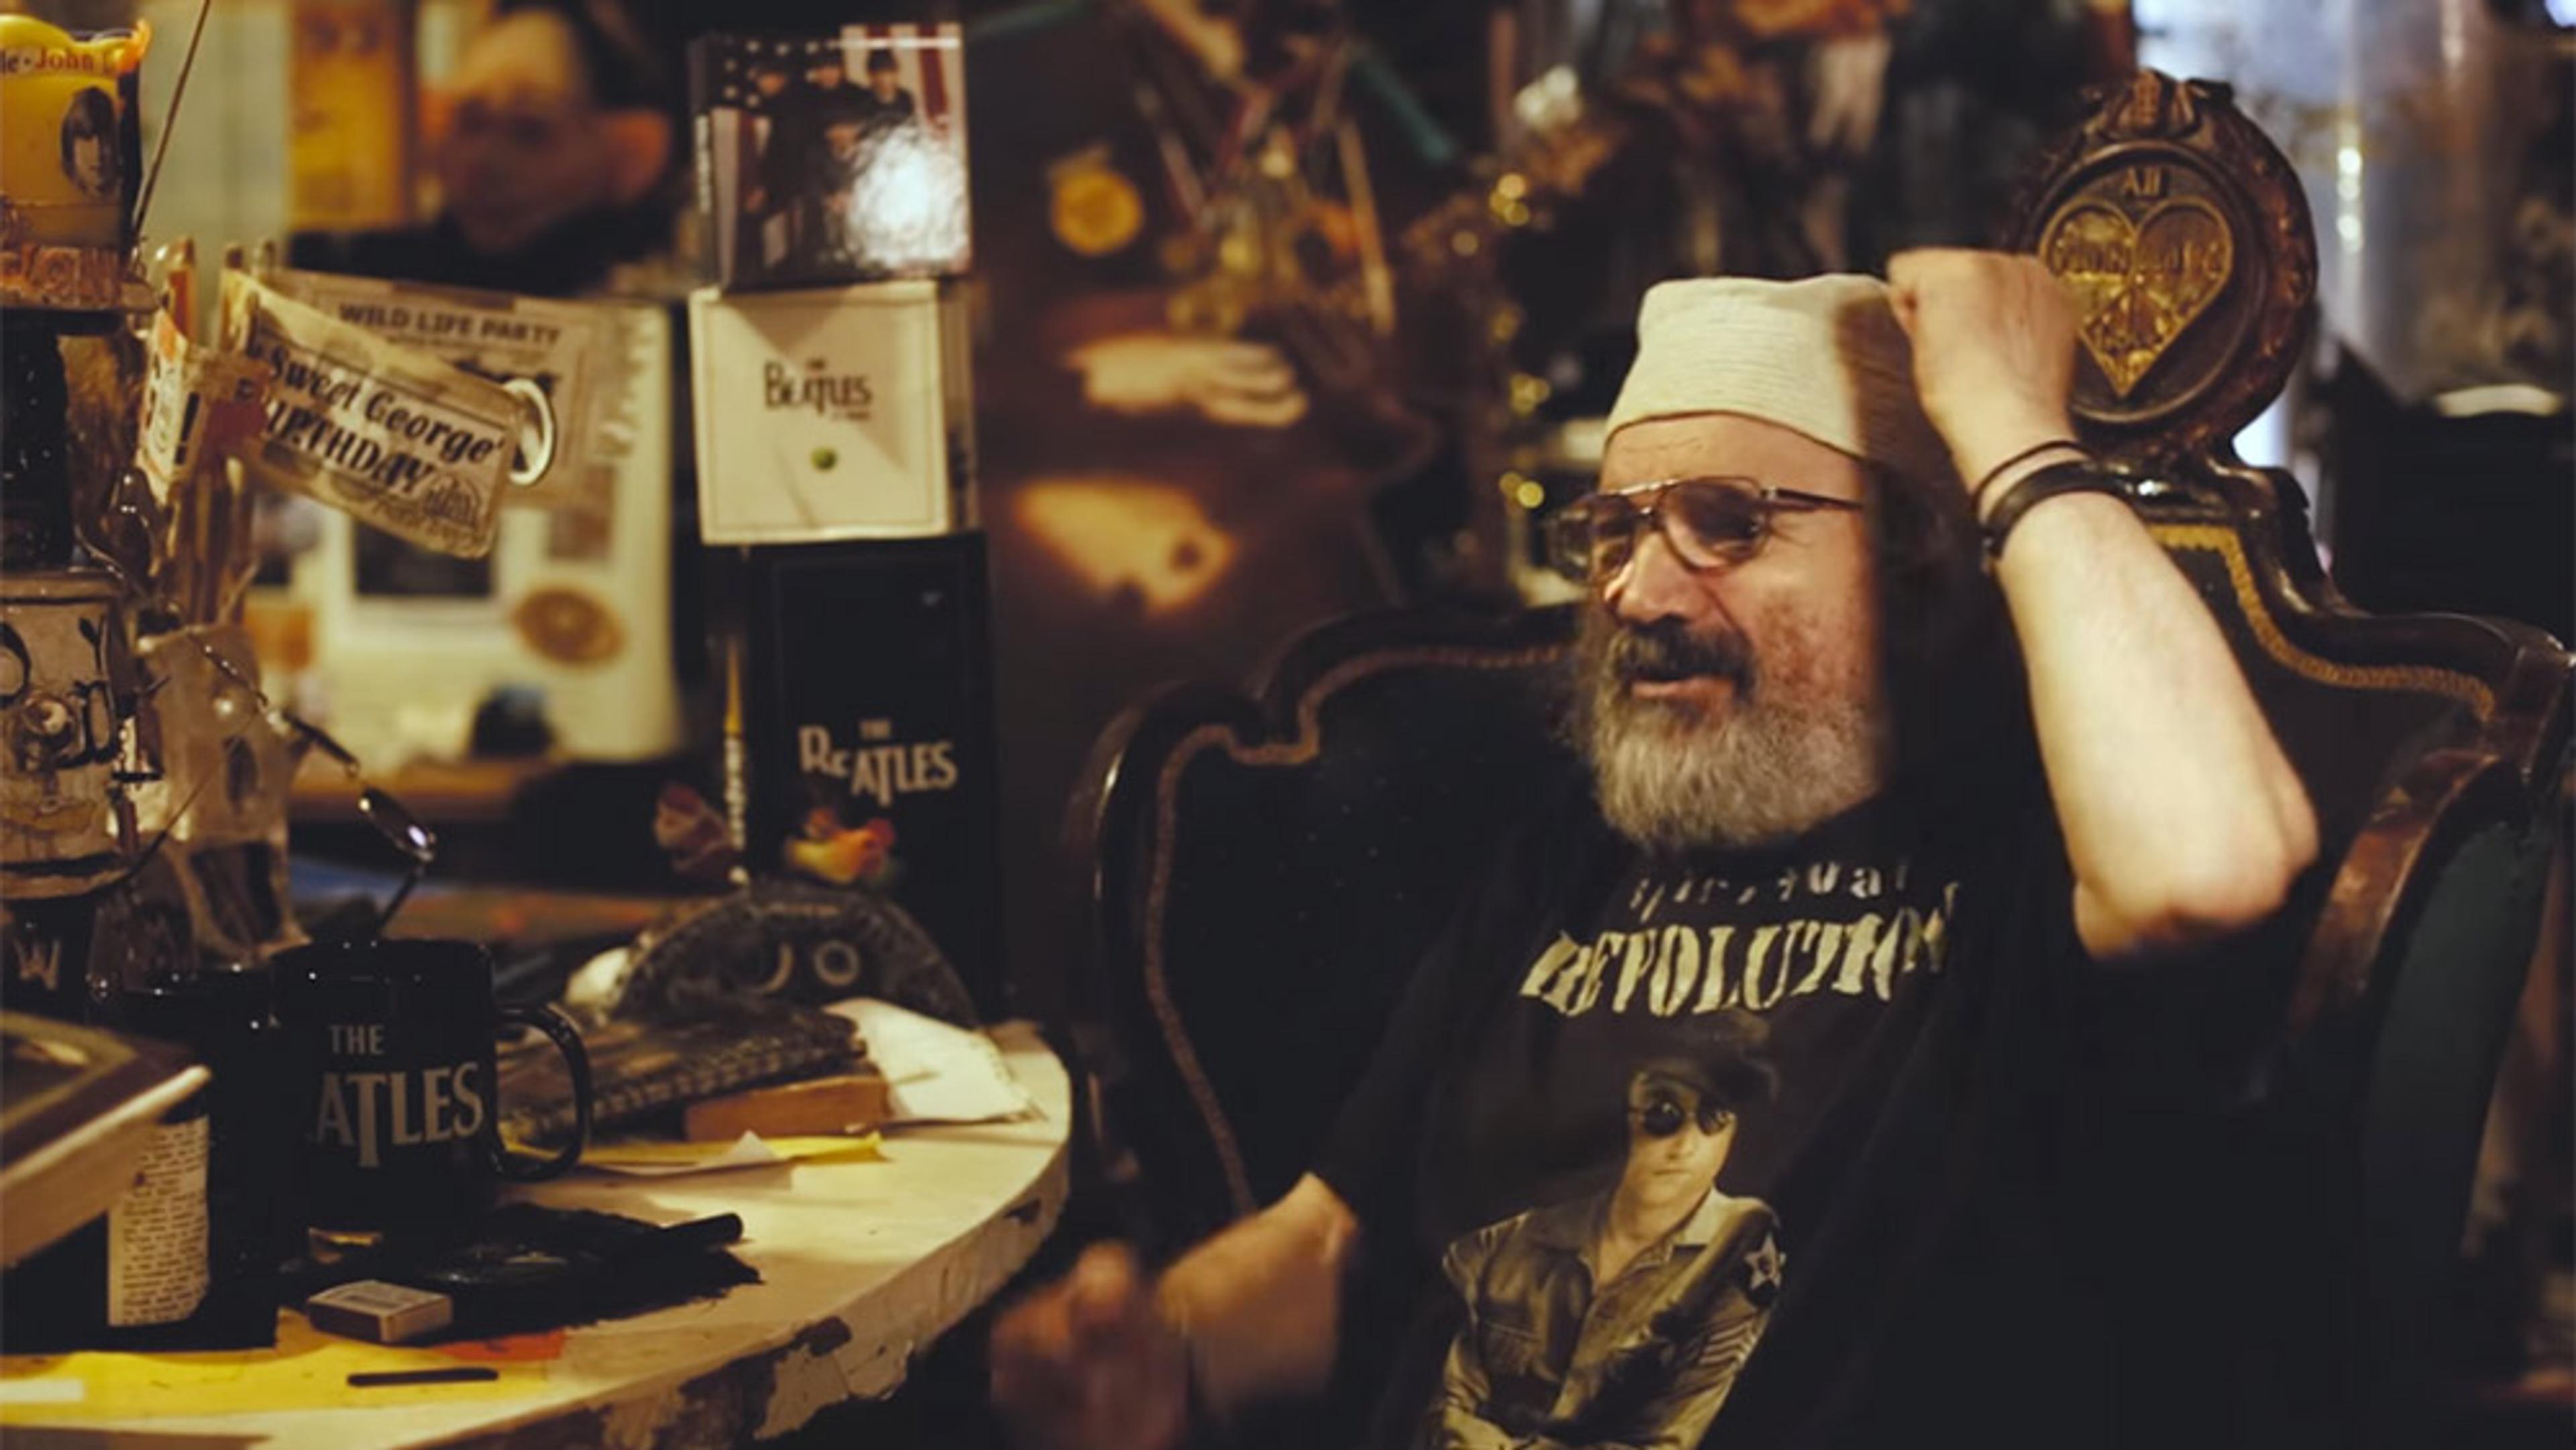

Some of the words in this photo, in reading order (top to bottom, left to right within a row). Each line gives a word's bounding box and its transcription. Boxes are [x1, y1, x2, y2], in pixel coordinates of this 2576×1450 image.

[36, 46, 95, 70] John
[340, 303, 411, 328] WILD
[417, 313, 474, 334] LIFE
[482, 317, 561, 345] PARTY
[270, 345, 362, 410] Sweet
[799, 725, 957, 805] BEATLES
[330, 1024, 384, 1054] THE
